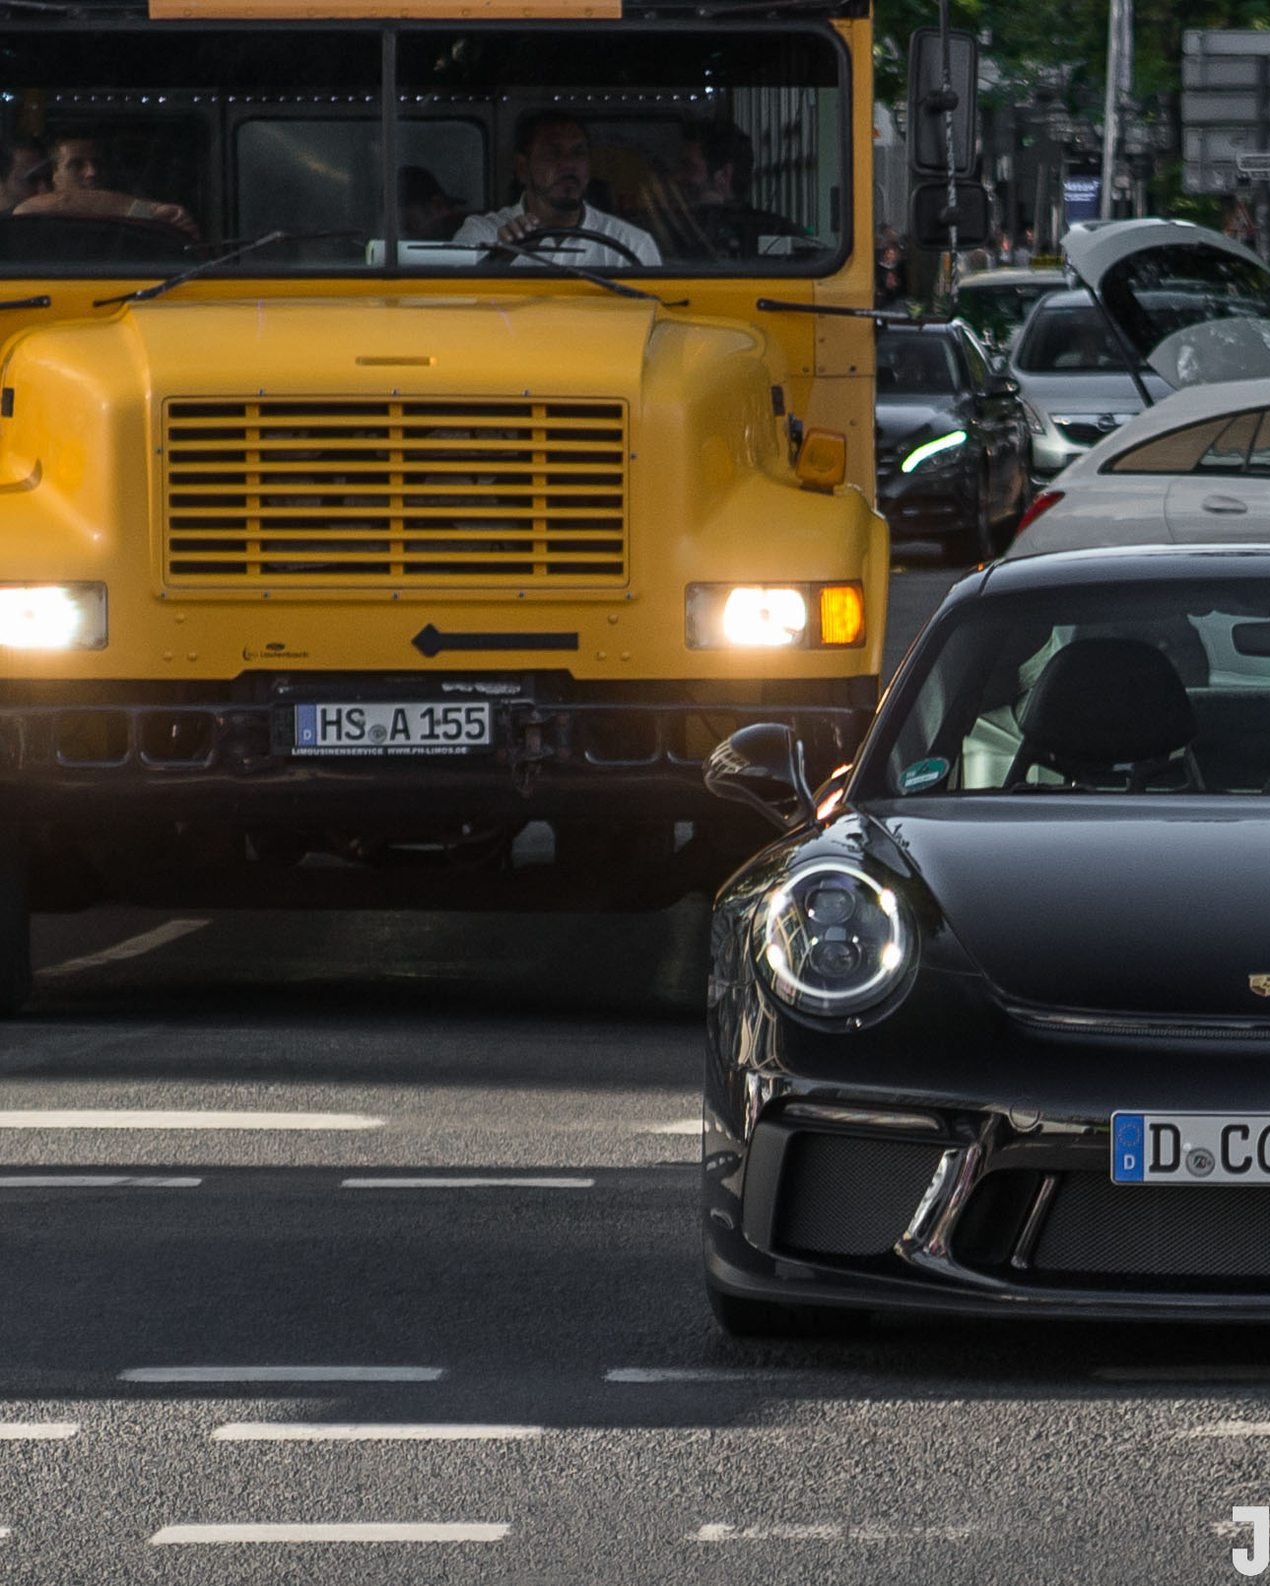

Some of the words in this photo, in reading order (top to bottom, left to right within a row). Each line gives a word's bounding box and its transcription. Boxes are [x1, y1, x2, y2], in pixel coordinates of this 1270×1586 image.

[320, 707, 366, 741] HS
[389, 708, 411, 741] A
[420, 707, 486, 741] 155
[291, 747, 383, 756] LIMOUSINENSERVICE
[1149, 1123, 1181, 1173] D
[1123, 1154, 1136, 1170] D
